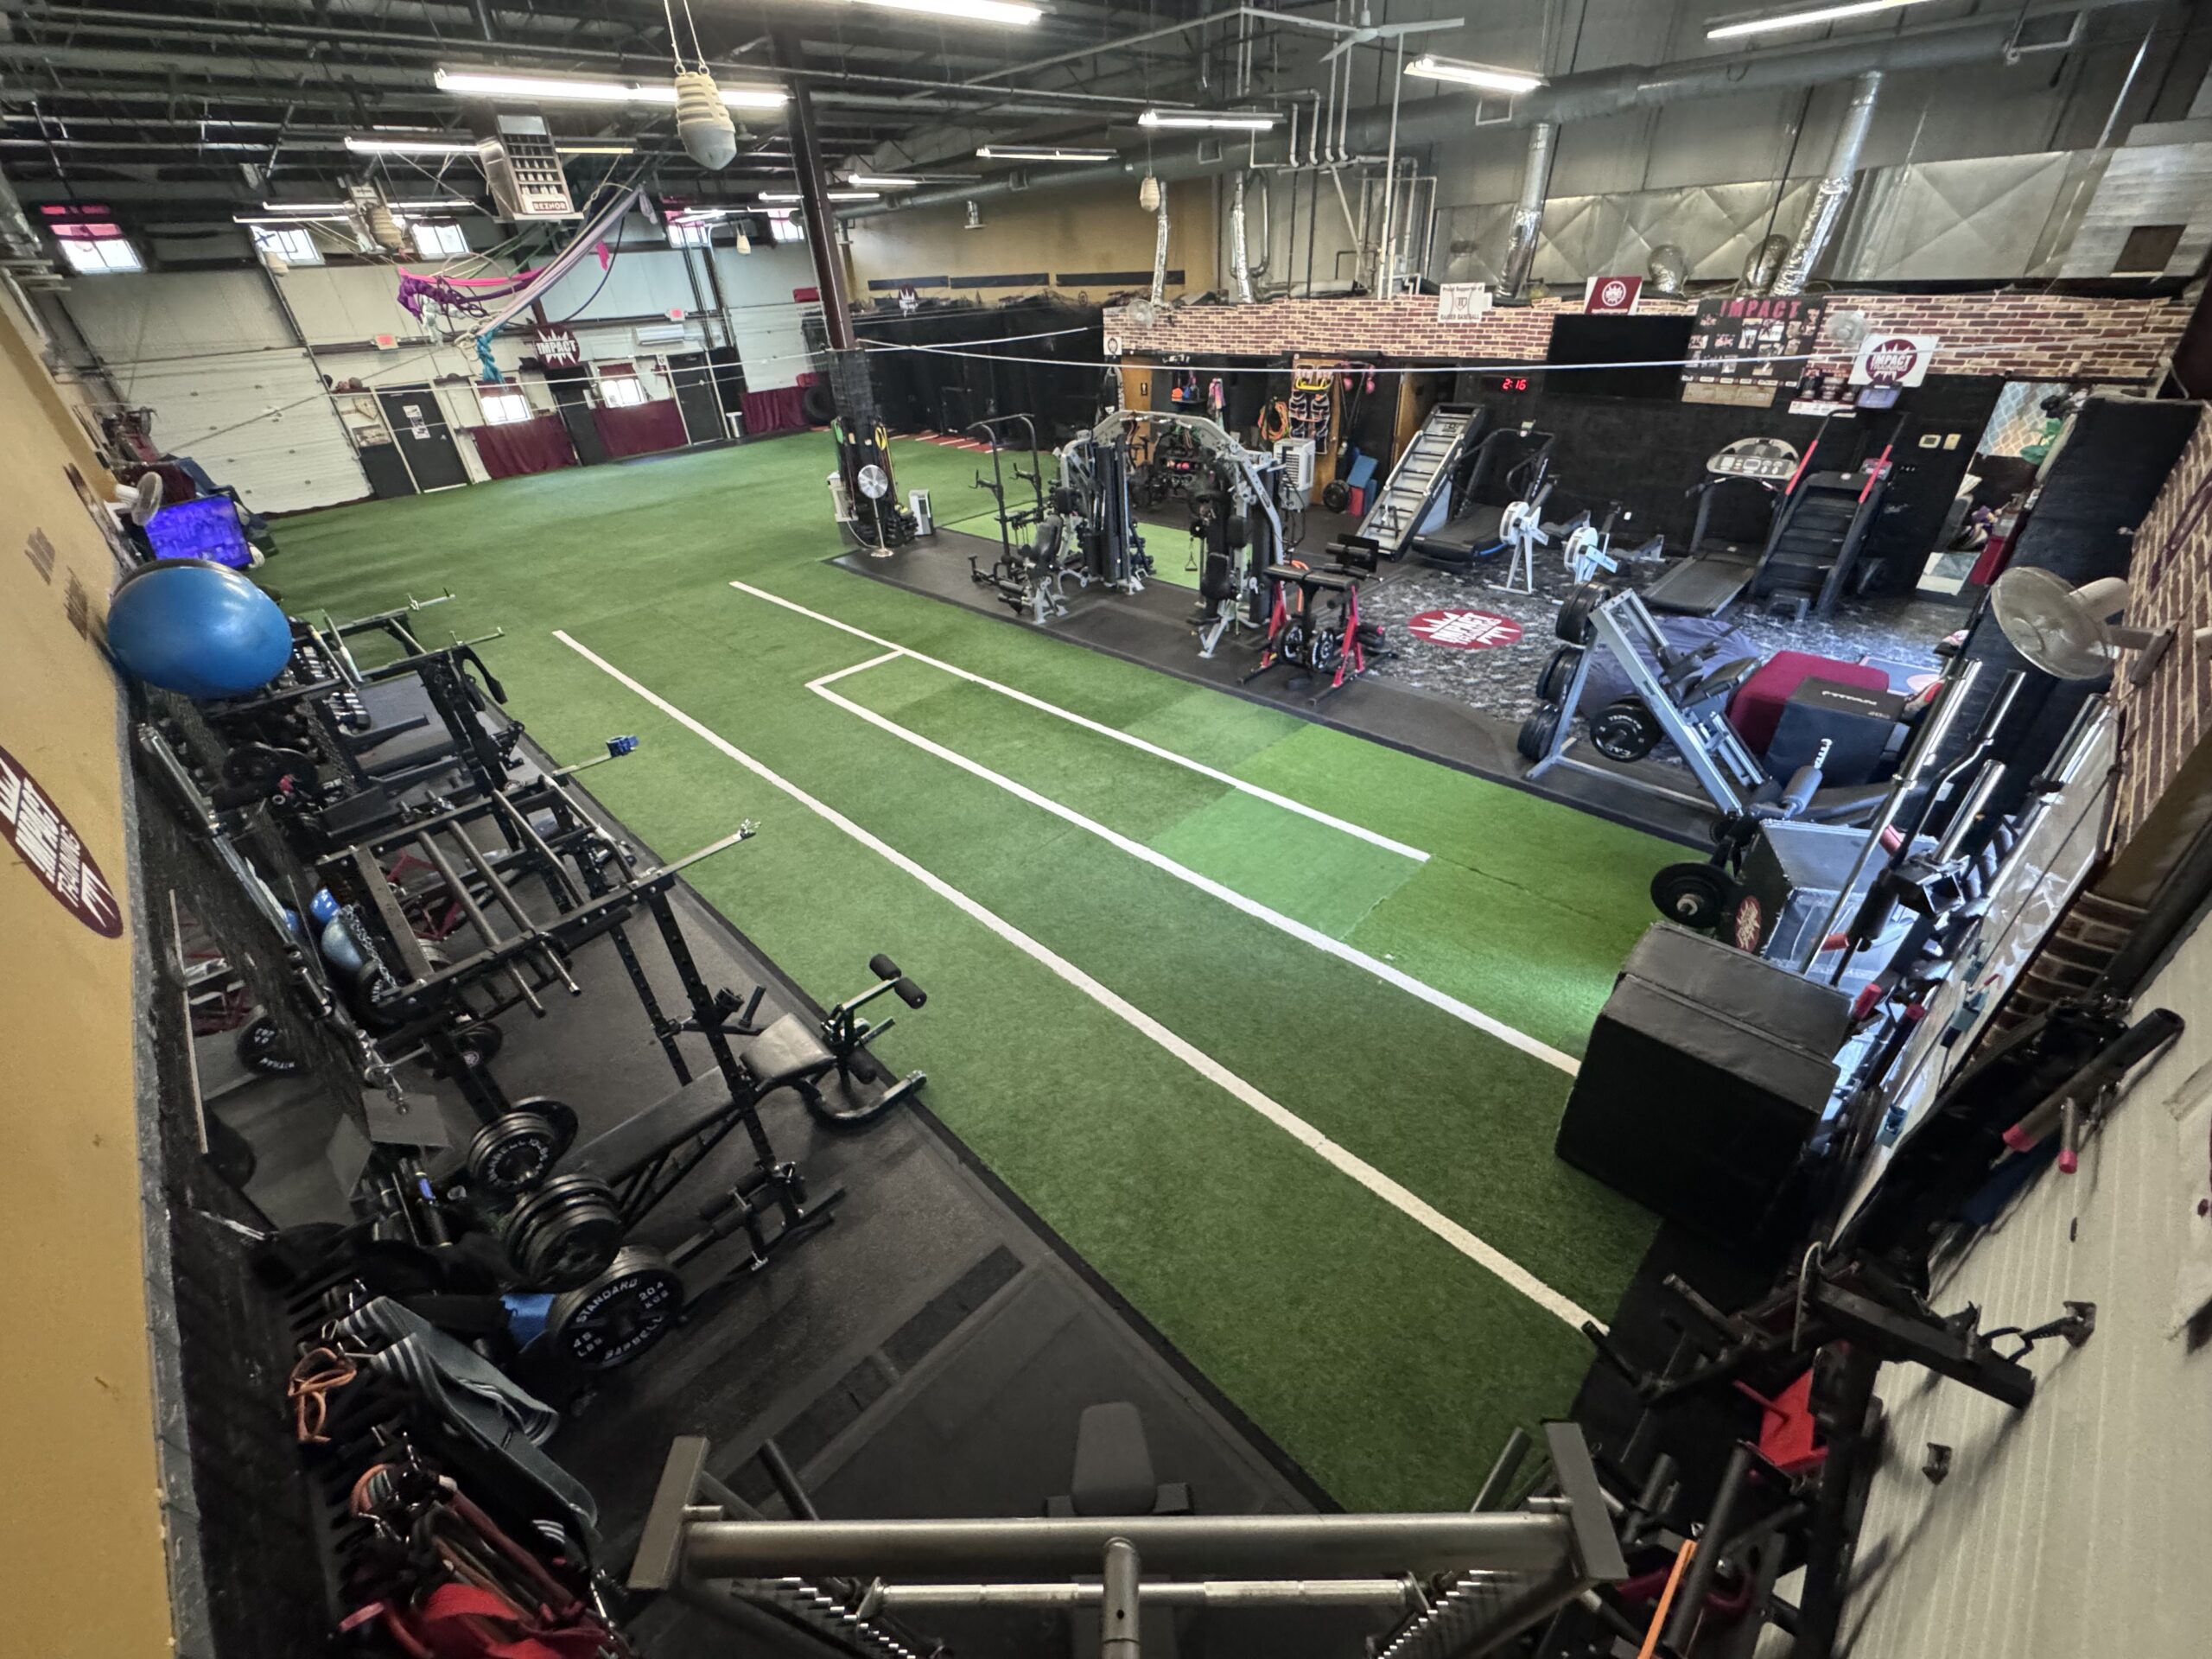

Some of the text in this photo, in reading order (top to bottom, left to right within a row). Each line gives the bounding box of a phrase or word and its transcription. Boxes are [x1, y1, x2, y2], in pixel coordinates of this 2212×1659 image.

[1719, 300, 1802, 319] IMPACT
[536, 340, 577, 355] IMPACT
[1871, 355, 1913, 366] IMPACT
[1502, 378, 1527, 391] 2:16
[1429, 612, 1494, 641] IMPACT
[15, 777, 60, 885] IMPACT
[56, 823, 81, 908] TRAINING
[575, 1278, 639, 1323] STANDARD
[604, 1316, 664, 1360] BARBELL
